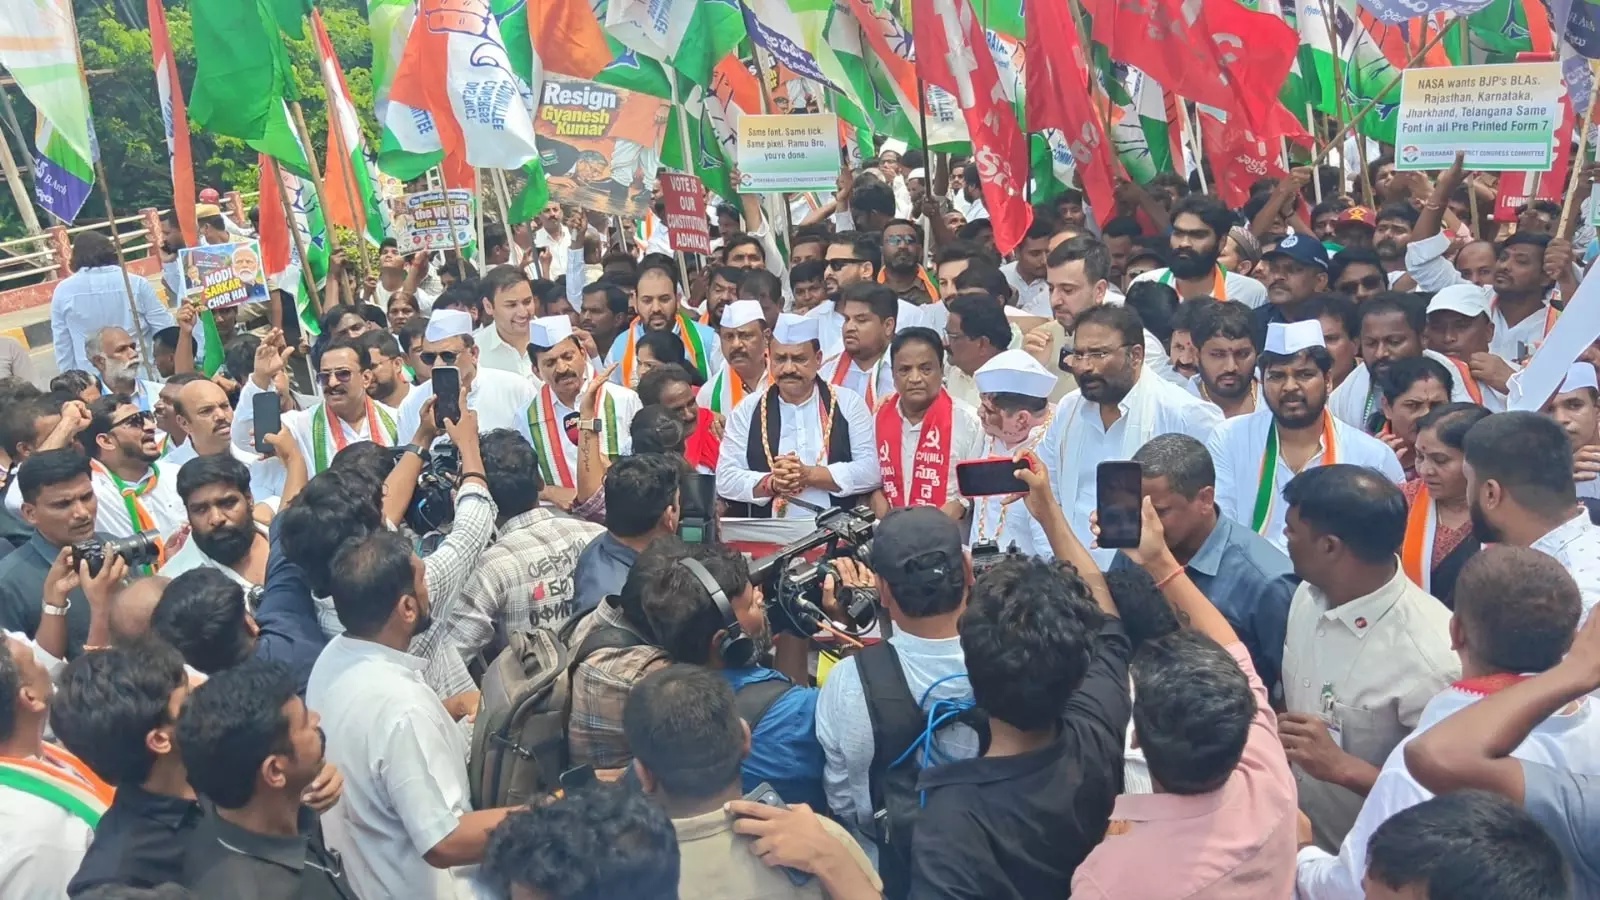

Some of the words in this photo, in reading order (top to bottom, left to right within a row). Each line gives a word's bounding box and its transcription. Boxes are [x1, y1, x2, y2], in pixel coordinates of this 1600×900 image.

[1418, 79, 1444, 89] NASA
[1447, 78, 1475, 88] wants
[1479, 76, 1507, 87] BJP's
[1510, 75, 1541, 86] BLAs.
[544, 82, 616, 110] Resign
[1424, 92, 1474, 104] Rajasthan,
[1477, 91, 1533, 103] Karnataka,
[542, 105, 609, 124] Gyanesh
[1405, 108, 1458, 119] Jharkhand,
[1462, 107, 1512, 118] Telangana
[1516, 105, 1546, 116] Same
[556, 121, 605, 136] Kumar
[748, 128, 766, 136] Same
[767, 127, 783, 136] font.
[785, 128, 805, 136] Same
[808, 126, 823, 135] tick.
[1402, 123, 1422, 133] Font
[1425, 122, 1433, 132] in
[1437, 121, 1448, 132] all
[1452, 122, 1469, 131] Pre
[1472, 121, 1507, 131] Printed
[1511, 121, 1538, 131] Form
[1542, 120, 1548, 130] 7
[747, 140, 764, 148] Same
[767, 140, 786, 149] pixel.
[788, 139, 808, 148] Ramu
[811, 139, 826, 148] Bro,
[764, 152, 785, 161] you're
[787, 151, 807, 159] done.
[670, 176, 691, 192] VOTE
[691, 178, 698, 194] IS
[679, 196, 696, 211] OUR
[205, 267, 232, 287] MODI
[204, 278, 242, 298] SARKAR
[207, 292, 231, 309] CHOR
[231, 287, 248, 300] HAI
